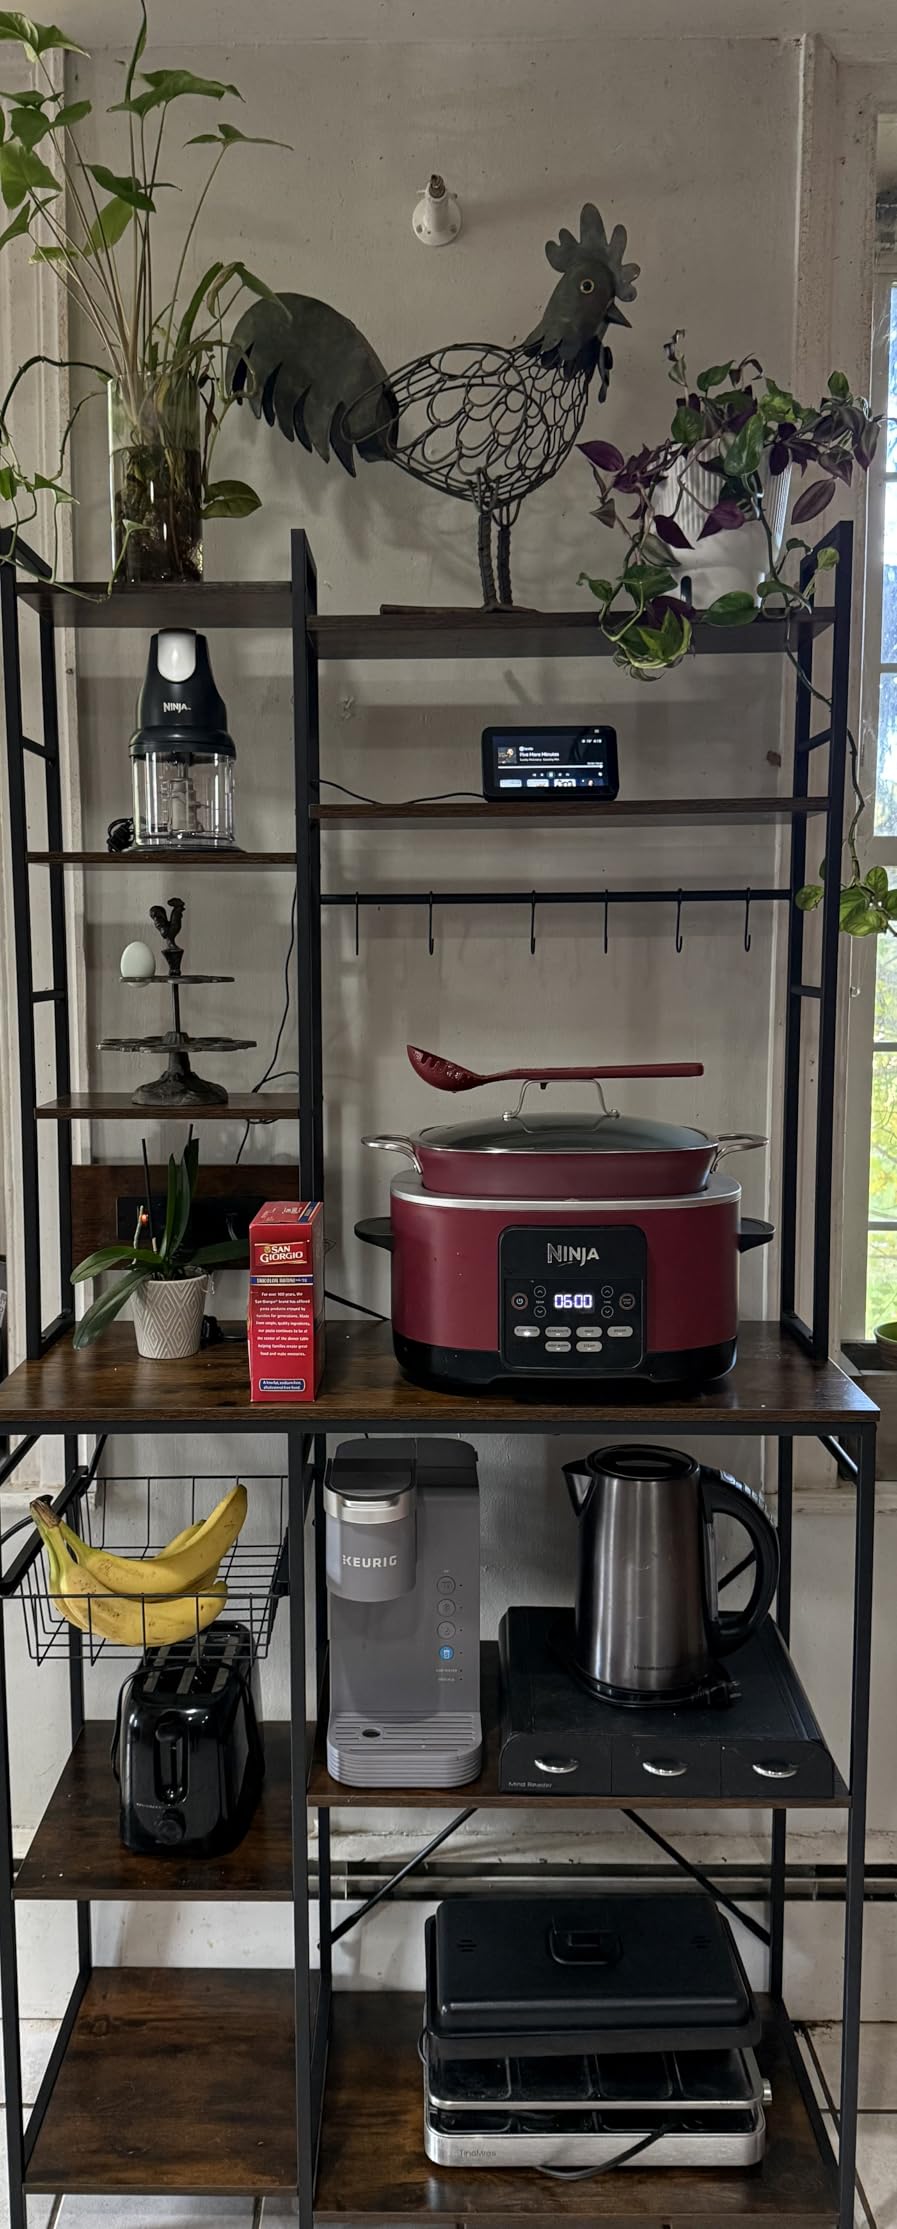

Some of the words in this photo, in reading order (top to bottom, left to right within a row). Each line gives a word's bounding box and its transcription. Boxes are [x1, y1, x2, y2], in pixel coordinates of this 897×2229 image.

[163, 702, 188, 714] NINJA
[260, 1252, 303, 1262] GIORGIO
[547, 1242, 600, 1266] NINJA
[342, 1554, 397, 1568] KEURIG
